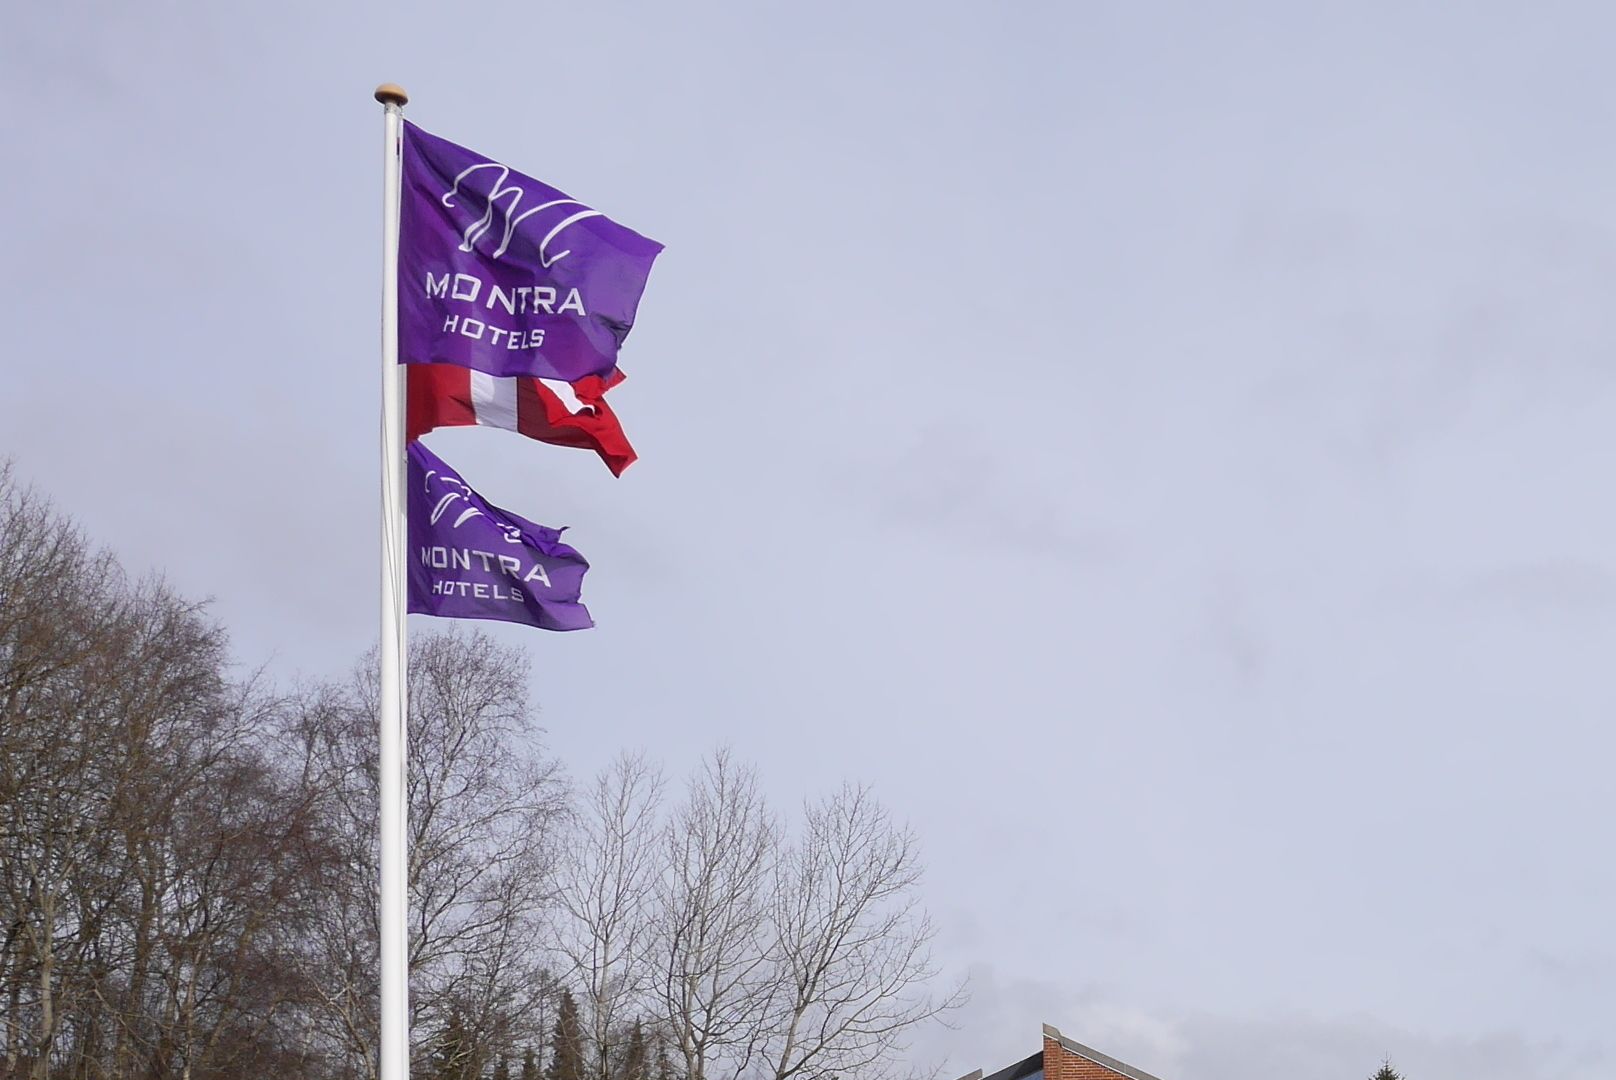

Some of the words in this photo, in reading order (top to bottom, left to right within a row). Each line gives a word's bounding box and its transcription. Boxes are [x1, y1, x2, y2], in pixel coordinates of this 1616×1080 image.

[425, 271, 586, 317] MONTRA
[442, 314, 545, 350] HOTELS
[421, 546, 552, 588] MONTRA
[432, 580, 524, 602] HOTELS
